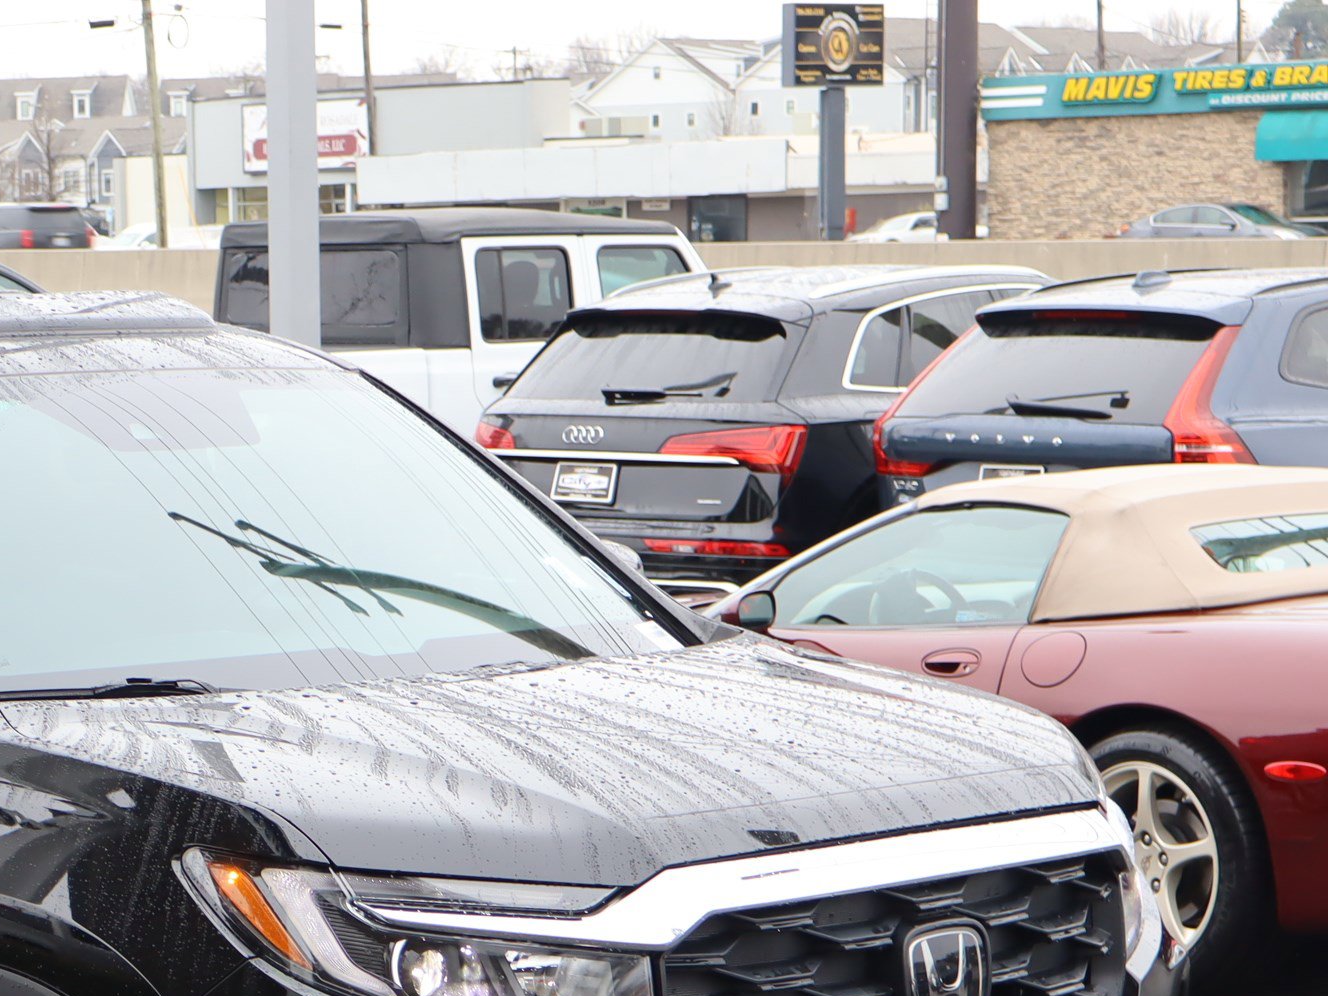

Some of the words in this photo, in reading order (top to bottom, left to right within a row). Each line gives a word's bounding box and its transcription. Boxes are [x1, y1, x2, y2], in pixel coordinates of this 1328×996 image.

[1062, 73, 1156, 101] MAVIS
[1173, 69, 1247, 90] TIRES
[1251, 70, 1267, 87] &
[1221, 93, 1288, 104] DISCOUNT
[945, 433, 1063, 446] VOLVO
